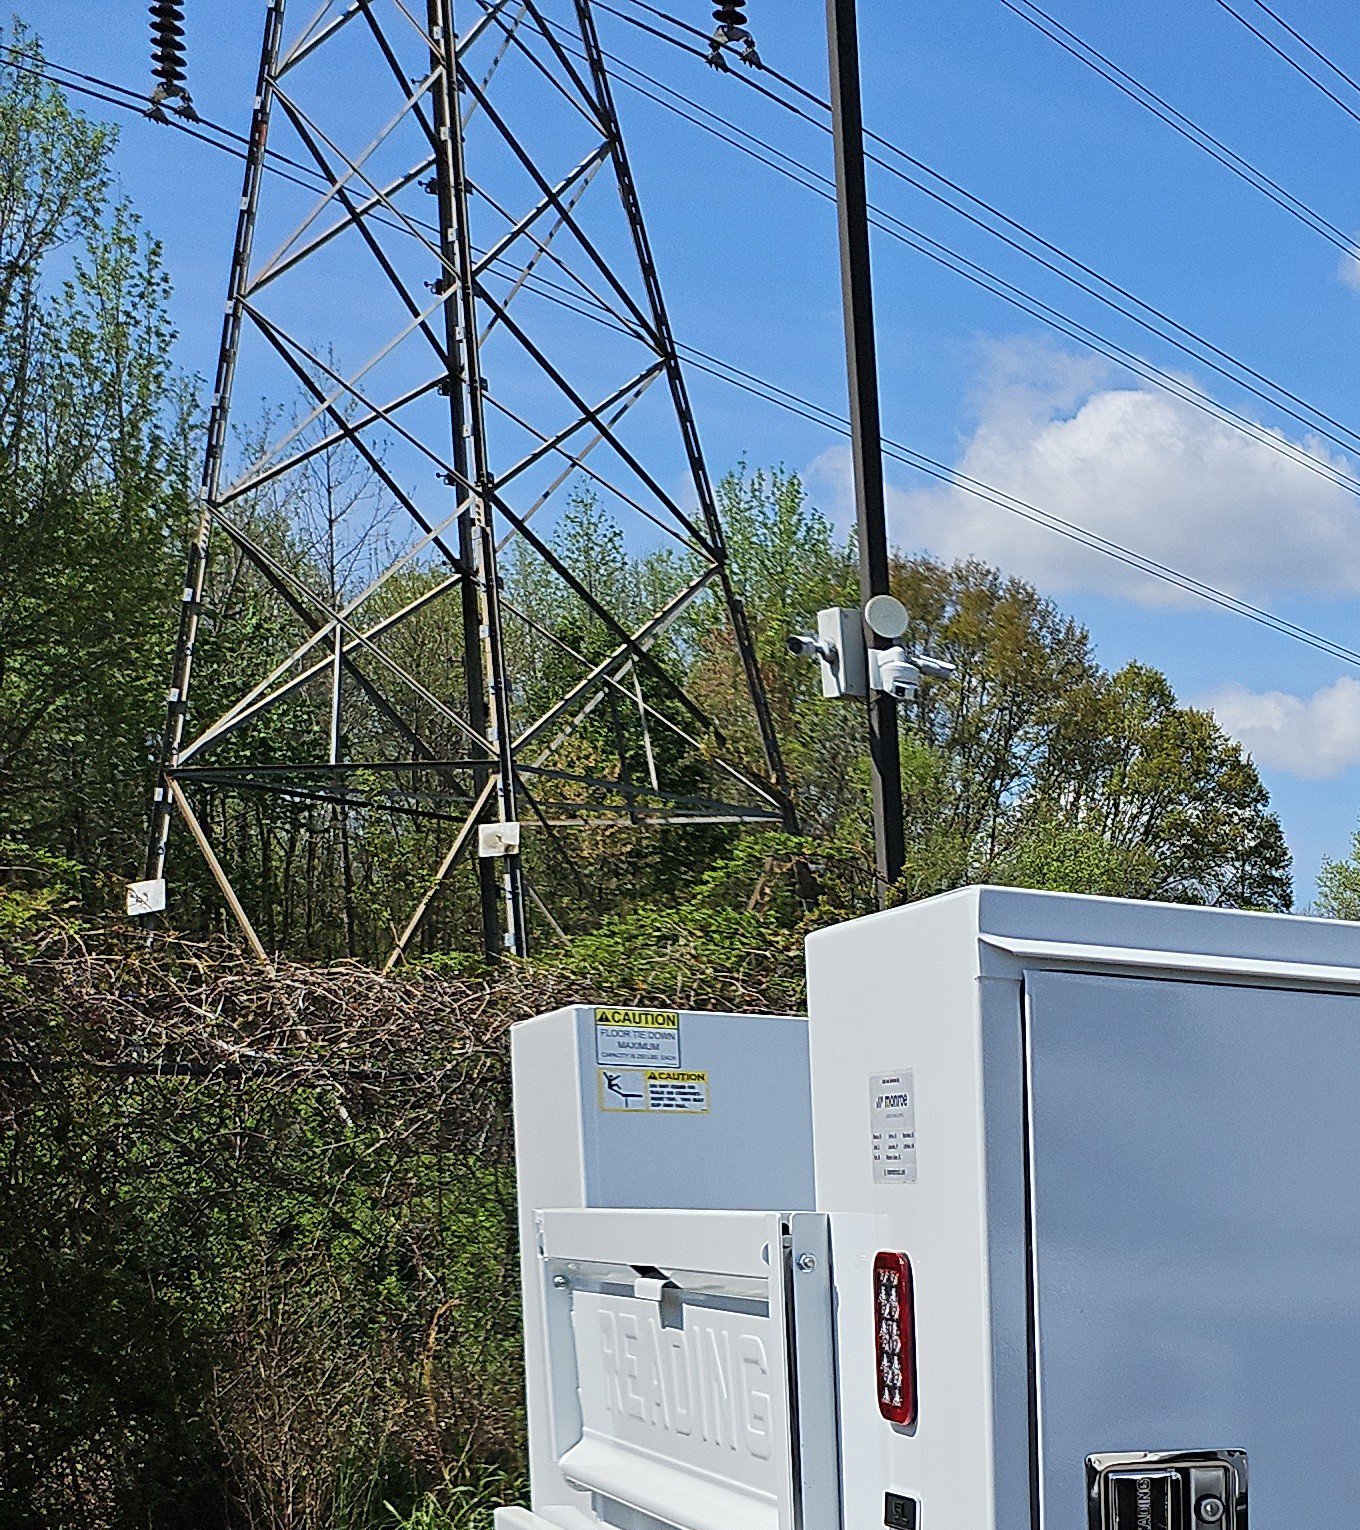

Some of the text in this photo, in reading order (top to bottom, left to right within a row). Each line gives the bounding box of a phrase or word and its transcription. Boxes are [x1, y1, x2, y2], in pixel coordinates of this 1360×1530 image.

[611, 1011, 676, 1026] CAUTION
[600, 1028, 676, 1040] FLOOR TIE DOWN
[658, 1072, 706, 1081] CAUTION
[598, 1309, 775, 1461] READING
